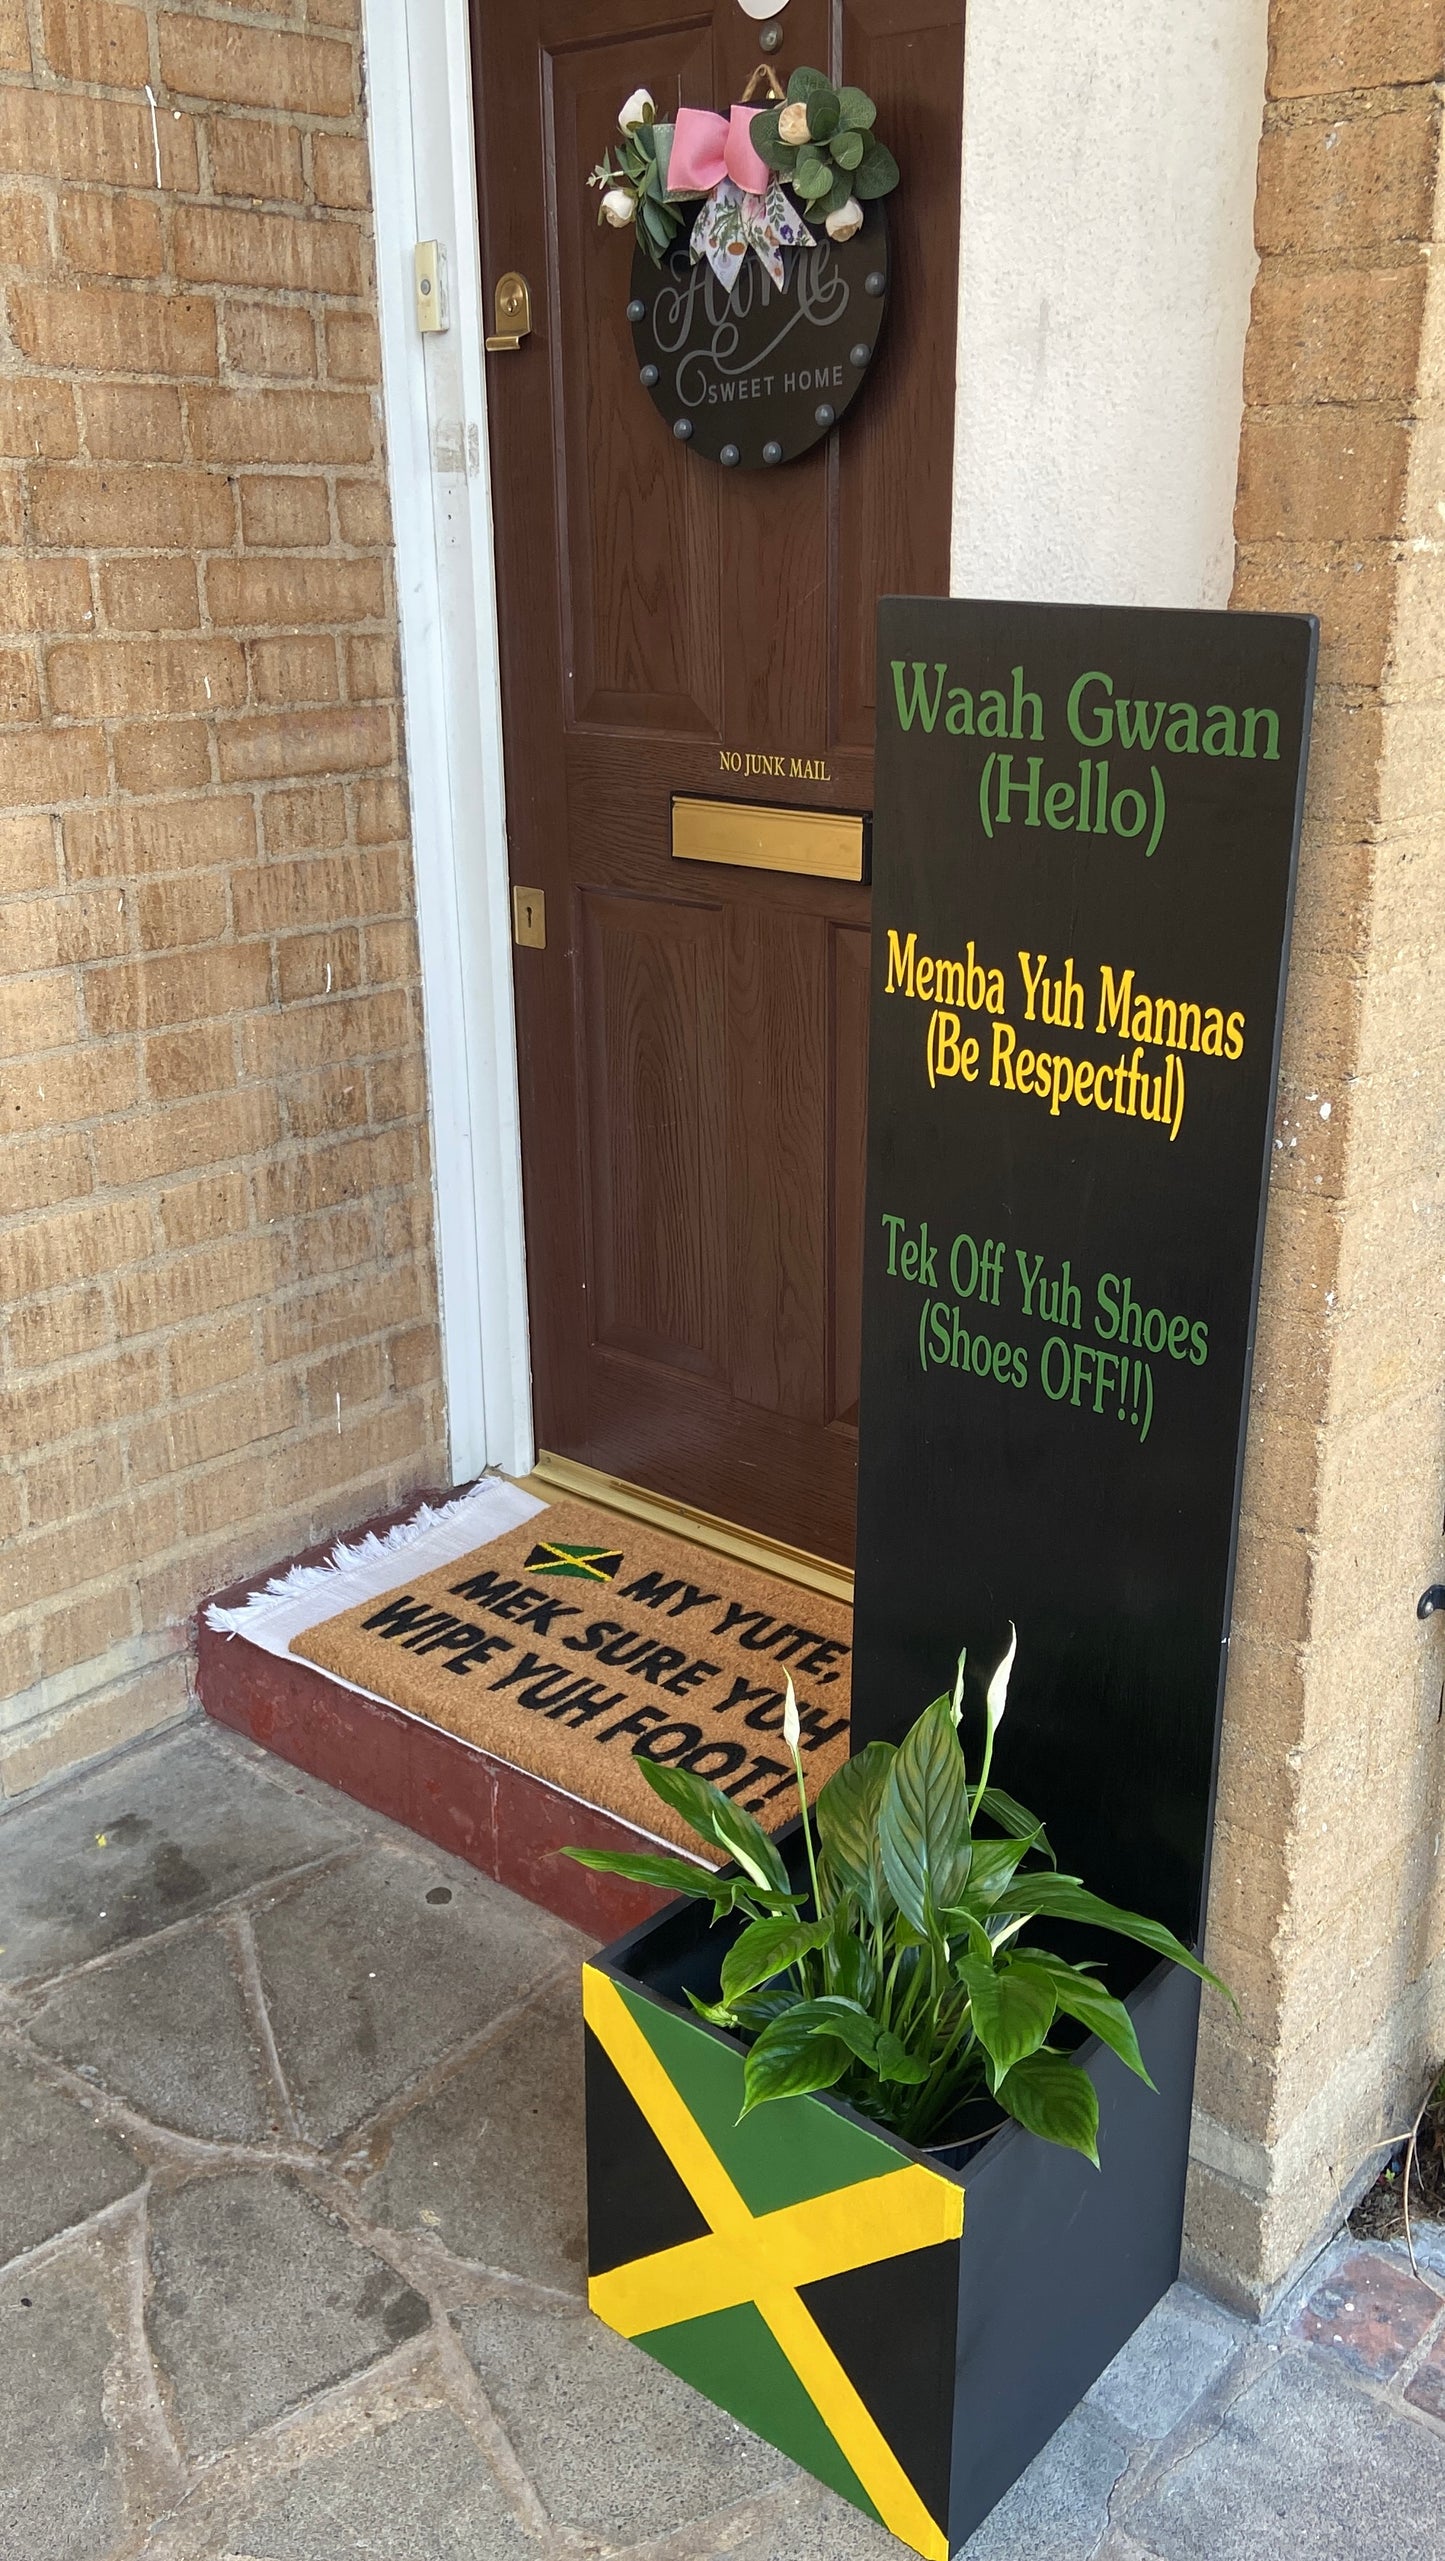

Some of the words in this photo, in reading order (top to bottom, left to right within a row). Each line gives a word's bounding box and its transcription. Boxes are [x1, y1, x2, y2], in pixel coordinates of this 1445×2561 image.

[708, 376, 774, 404] SWEET
[784, 365, 843, 393] HOME
[719, 750, 742, 772] NO
[744, 753, 786, 777] JUNK
[789, 757, 831, 781] MAIL
[890, 660, 1045, 742] Waah
[1066, 670, 1281, 761] Gwaan
[979, 751, 1166, 857] (Hello)
[884, 929, 1005, 1015] Memba
[1017, 950, 1085, 1030] Yuh
[1095, 965, 1246, 1061] Mannas
[926, 1008, 980, 1089] (Be
[989, 1020, 1186, 1142] Respectful)
[881, 1212, 938, 1289] Tek
[949, 1233, 1007, 1307] Off
[1014, 1249, 1082, 1330] Yuh
[1094, 1272, 1210, 1367] Shoes
[918, 1297, 1029, 1389] (Shoes
[1040, 1335, 1155, 1444] OFF!!)
[449, 1570, 586, 1637] MEK
[565, 1621, 721, 1697] SURE
[714, 1677, 851, 1752] YUH
[617, 1571, 722, 1617] MY
[709, 1603, 852, 1686] YUTE,
[360, 1596, 516, 1676] WIPE
[486, 1653, 629, 1729] YUH
[594, 1705, 808, 1813] FOOT!
